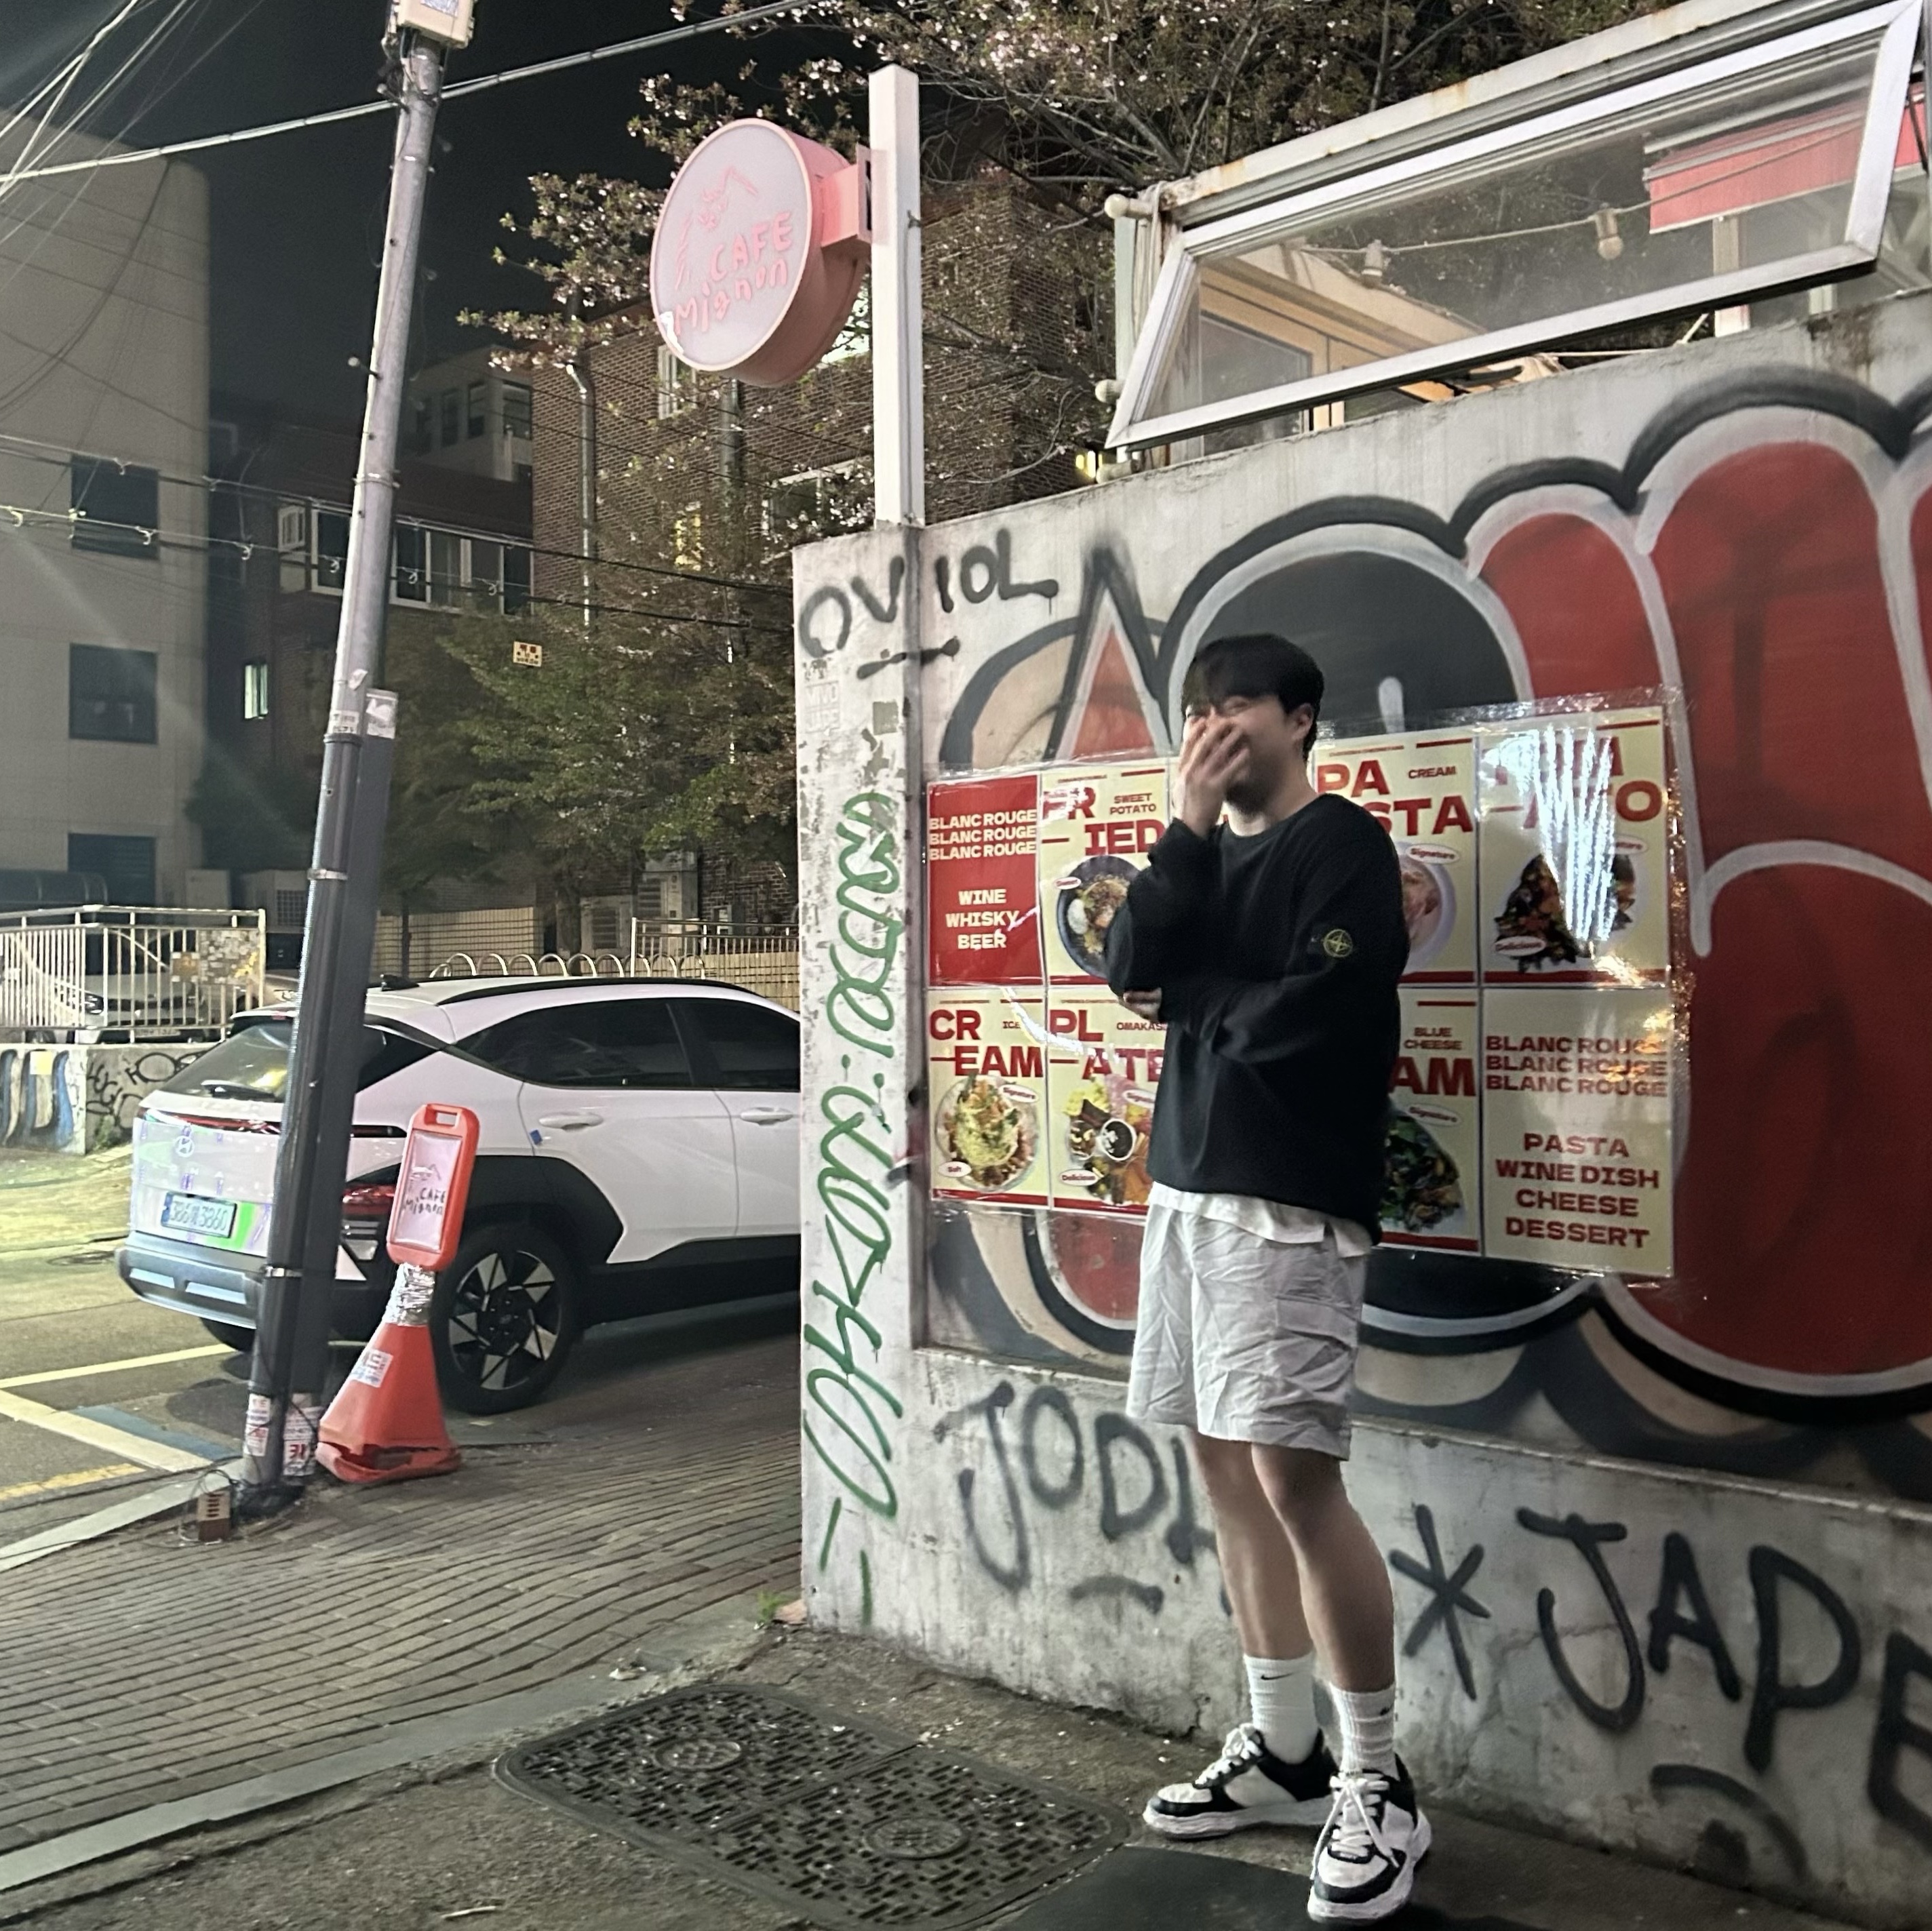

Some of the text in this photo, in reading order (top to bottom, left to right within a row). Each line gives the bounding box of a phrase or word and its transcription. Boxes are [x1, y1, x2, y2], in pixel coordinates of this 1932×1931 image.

[710, 211, 792, 281] CAFE
[1317, 759, 1390, 797] PA
[1408, 765, 1457, 779] CREAM
[1113, 793, 1152, 803] SWEET
[1109, 803, 1157, 815] POTATO
[930, 809, 1037, 830] BLANC ROUGE
[930, 825, 1036, 845] BLANC ROUGE
[1085, 819, 1166, 856] IED
[930, 841, 1036, 861] BLANC ROUGE
[958, 889, 1007, 905] WINE
[945, 911, 1020, 928] WHISKY
[958, 933, 1007, 949] BEER
[930, 1009, 982, 1041] CR
[1050, 1010, 1104, 1042] PL
[1414, 1027, 1453, 1037] BLUE
[1403, 1039, 1463, 1050] CHEESE
[1486, 1035, 1572, 1052] BLANC
[955, 1046, 1044, 1077] EAM
[1486, 1055, 1572, 1073] BLANC
[1486, 1075, 1668, 1098] BLANC ROUGE
[1524, 1132, 1630, 1157] PASTA
[1495, 1158, 1660, 1189] WINE DISH
[1516, 1189, 1639, 1216] CHEESE
[1505, 1217, 1651, 1249] DESSERT
